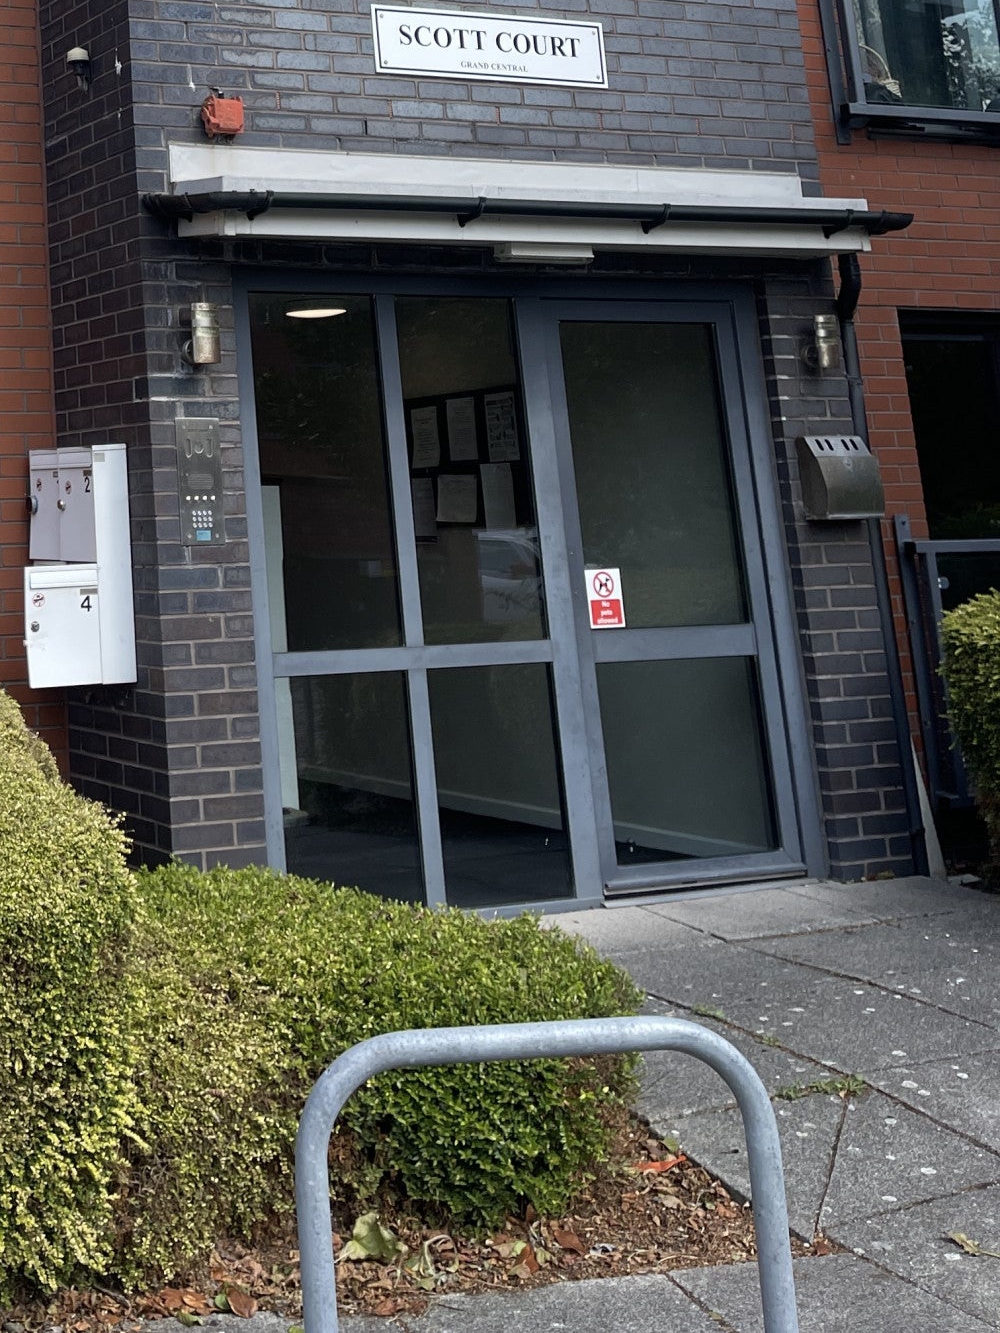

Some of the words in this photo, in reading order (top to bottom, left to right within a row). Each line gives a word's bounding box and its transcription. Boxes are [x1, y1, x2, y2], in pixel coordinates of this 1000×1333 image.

[399, 24, 487, 51] SCOTT
[495, 31, 581, 58] COURT
[460, 60, 489, 70] GRAND
[490, 62, 529, 73] CENTRAL
[83, 476, 91, 493] 2
[80, 595, 93, 612] 4
[601, 600, 611, 608] No
